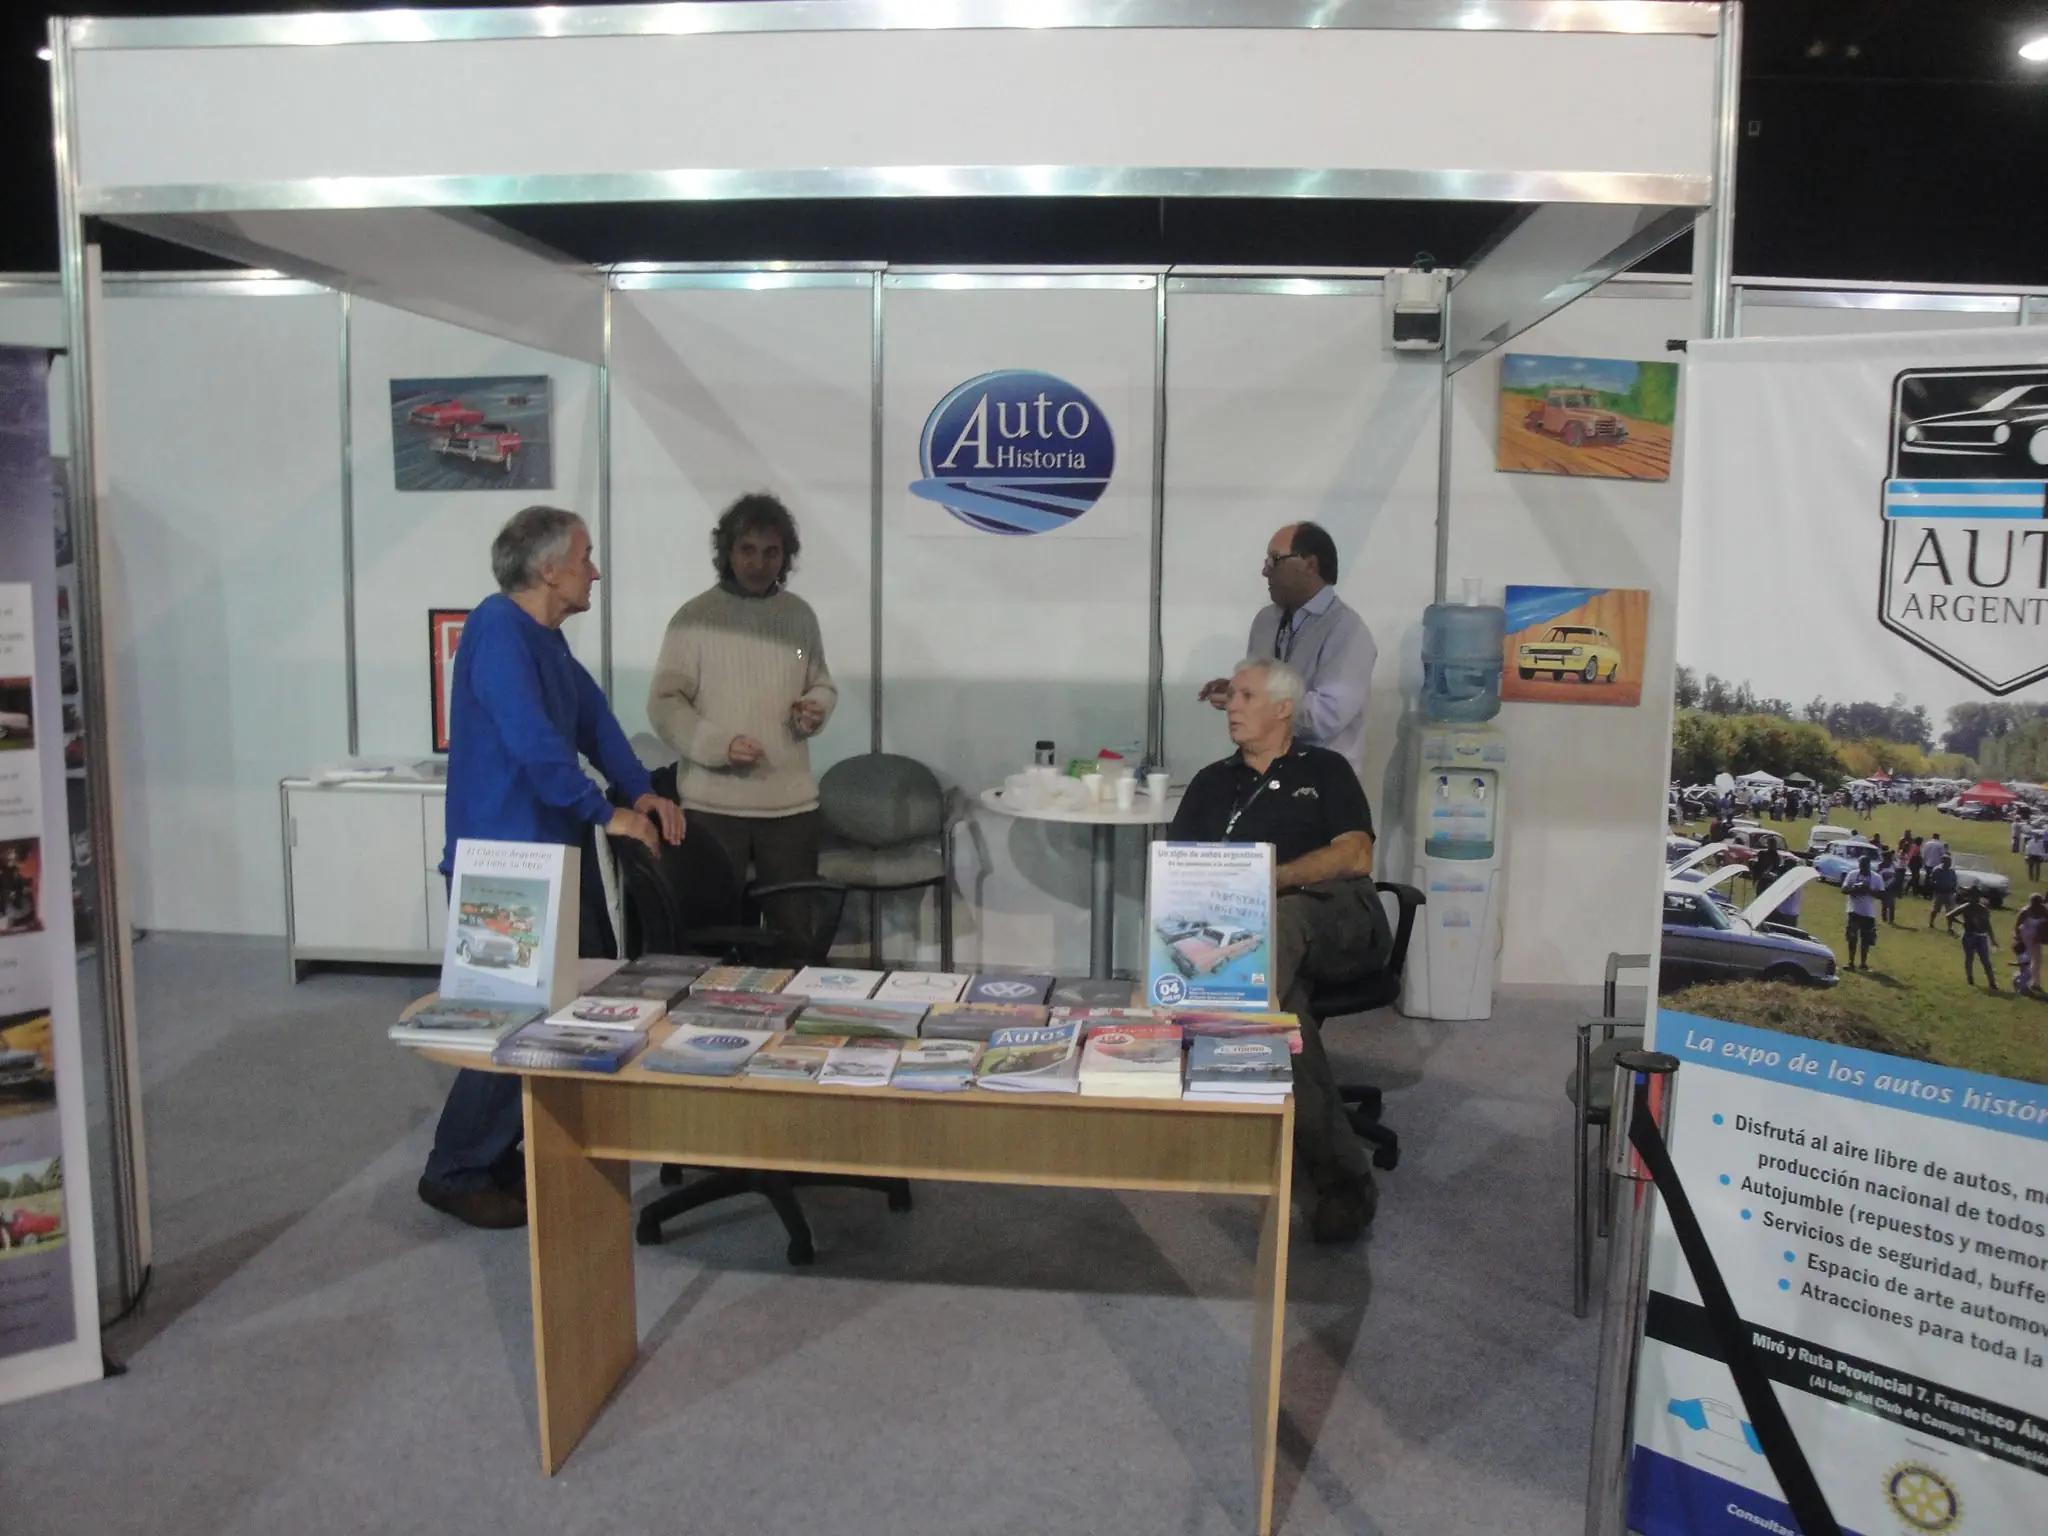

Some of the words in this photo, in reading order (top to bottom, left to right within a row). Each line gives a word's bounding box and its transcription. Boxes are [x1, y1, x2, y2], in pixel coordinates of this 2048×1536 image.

[937, 393, 1089, 468] Auto
[997, 446, 1086, 469] Historia
[1901, 593, 2048, 625] ARGENT
[1160, 982, 1180, 995] 04
[996, 1030, 1065, 1045] Autos
[1684, 1029, 1713, 1053] La
[1722, 1043, 1780, 1069] expo
[1788, 1051, 1819, 1074] de
[1828, 1059, 1865, 1085] los
[1875, 1074, 1952, 1103] autos
[1735, 1113, 1805, 1146] Disfrutá
[1810, 1134, 1828, 1151] al
[1833, 1140, 1868, 1161] aire
[1874, 1148, 1918, 1173] libre
[1923, 1160, 1947, 1181] de
[1953, 1168, 2018, 1201] autos,
[1740, 1176, 1844, 1217] Autojumble
[1849, 1204, 1954, 1248] (repuestos
[1958, 1235, 1971, 1253] y
[1758, 1152, 1860, 1192] producción
[1866, 1179, 1951, 1213] nacional
[1955, 1198, 1981, 1221] de
[1987, 1207, 2045, 1238] todos
[1762, 1210, 1845, 1248] Servicios
[1849, 1234, 1873, 1255] de
[1878, 1244, 1983, 1289] seguridad,
[1990, 1273, 2048, 1305] buffe
[1806, 1252, 1880, 1289] Espacio
[1884, 1274, 1909, 1296] de
[1914, 1286, 1955, 1311] arte
[1800, 1281, 1914, 1328] Atracciones
[1918, 1317, 1964, 1344] para
[1971, 1334, 2017, 1361] toda
[2024, 1346, 2044, 1368] la
[1752, 1332, 1786, 1355] Miró
[1787, 1346, 1796, 1360] y
[1799, 1347, 1833, 1370] Ruta
[1836, 1359, 1912, 1397] Provincial
[1916, 1386, 1930, 1404] 7.
[1934, 1393, 2017, 1432] Francisco
[1828, 1379, 1853, 1397] lado
[1855, 1389, 1873, 1405] del
[1875, 1397, 1902, 1415] Club
[1904, 1407, 1920, 1421] de
